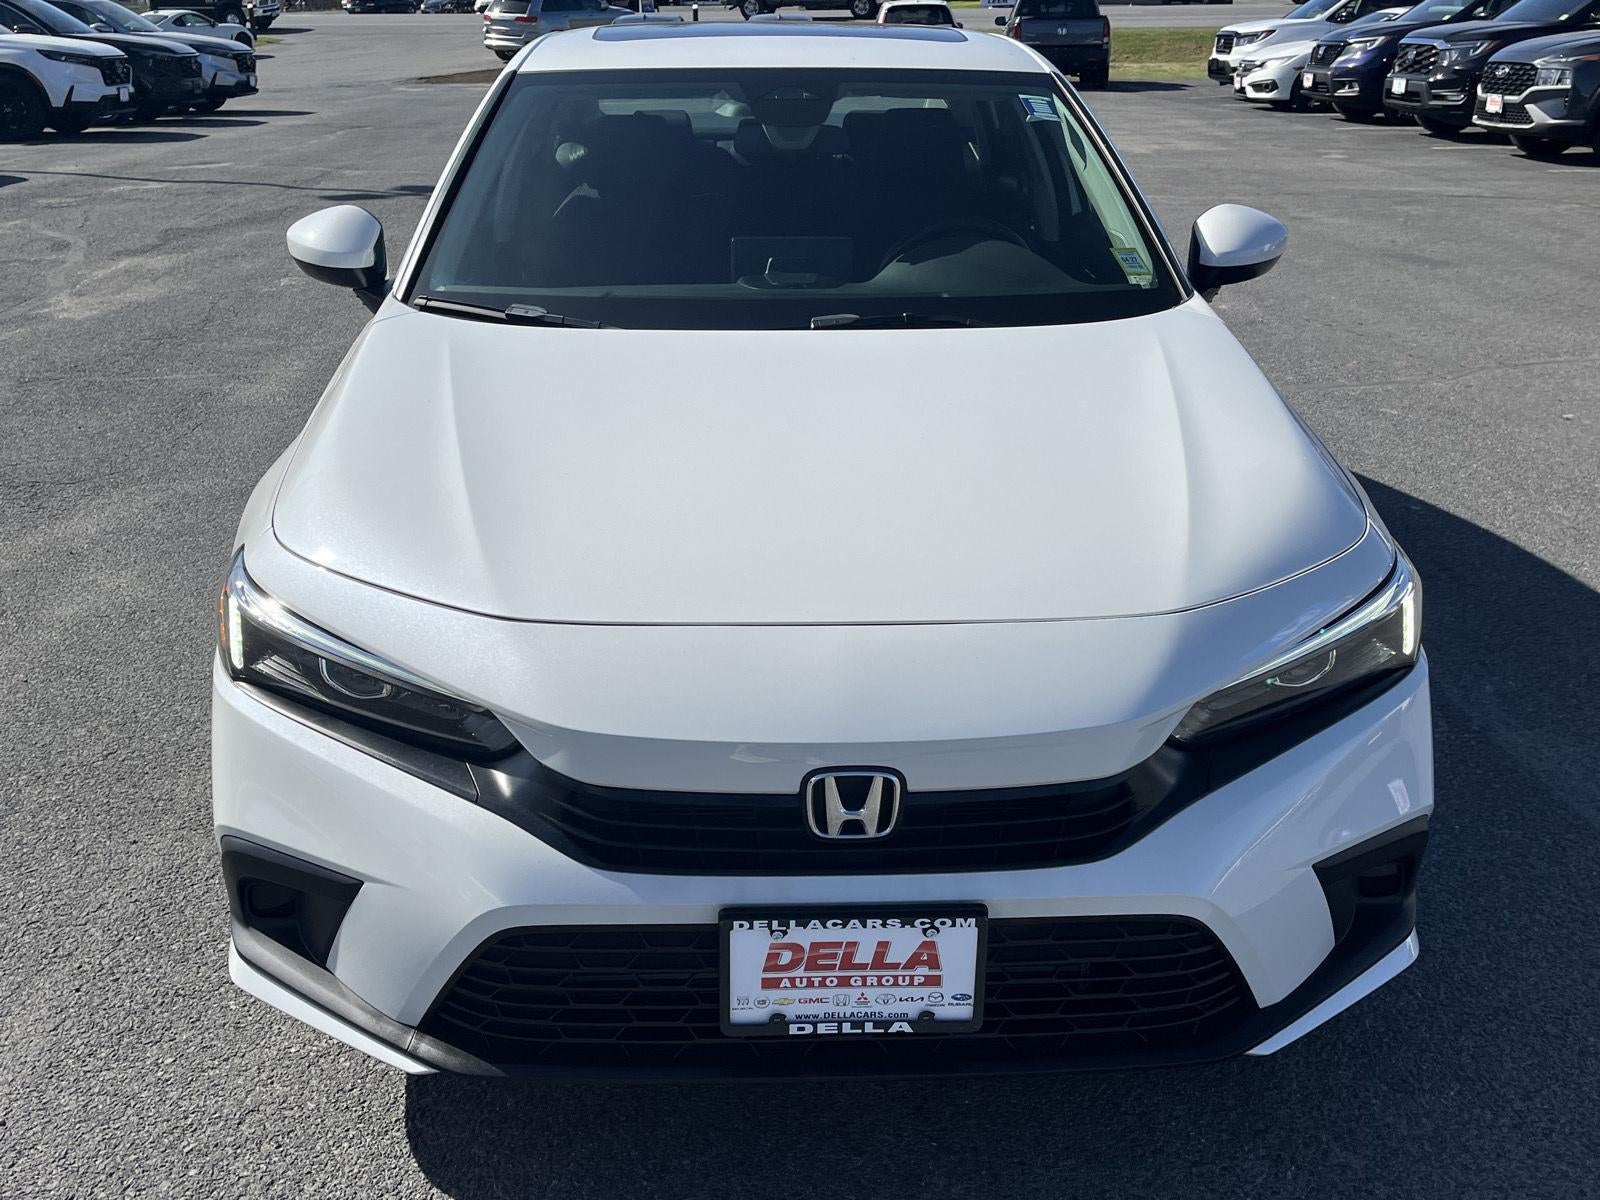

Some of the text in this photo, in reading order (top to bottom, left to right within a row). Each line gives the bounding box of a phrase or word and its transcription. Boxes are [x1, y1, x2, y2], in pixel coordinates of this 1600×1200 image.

[732, 917, 977, 931] DELLACARS.COM
[761, 940, 943, 974] DELLA
[779, 975, 926, 988] AUTO GROUP
[797, 997, 830, 1005] GMC
[794, 1010, 909, 1021] www.DELLACARS.com
[788, 1021, 914, 1036] DELLA
